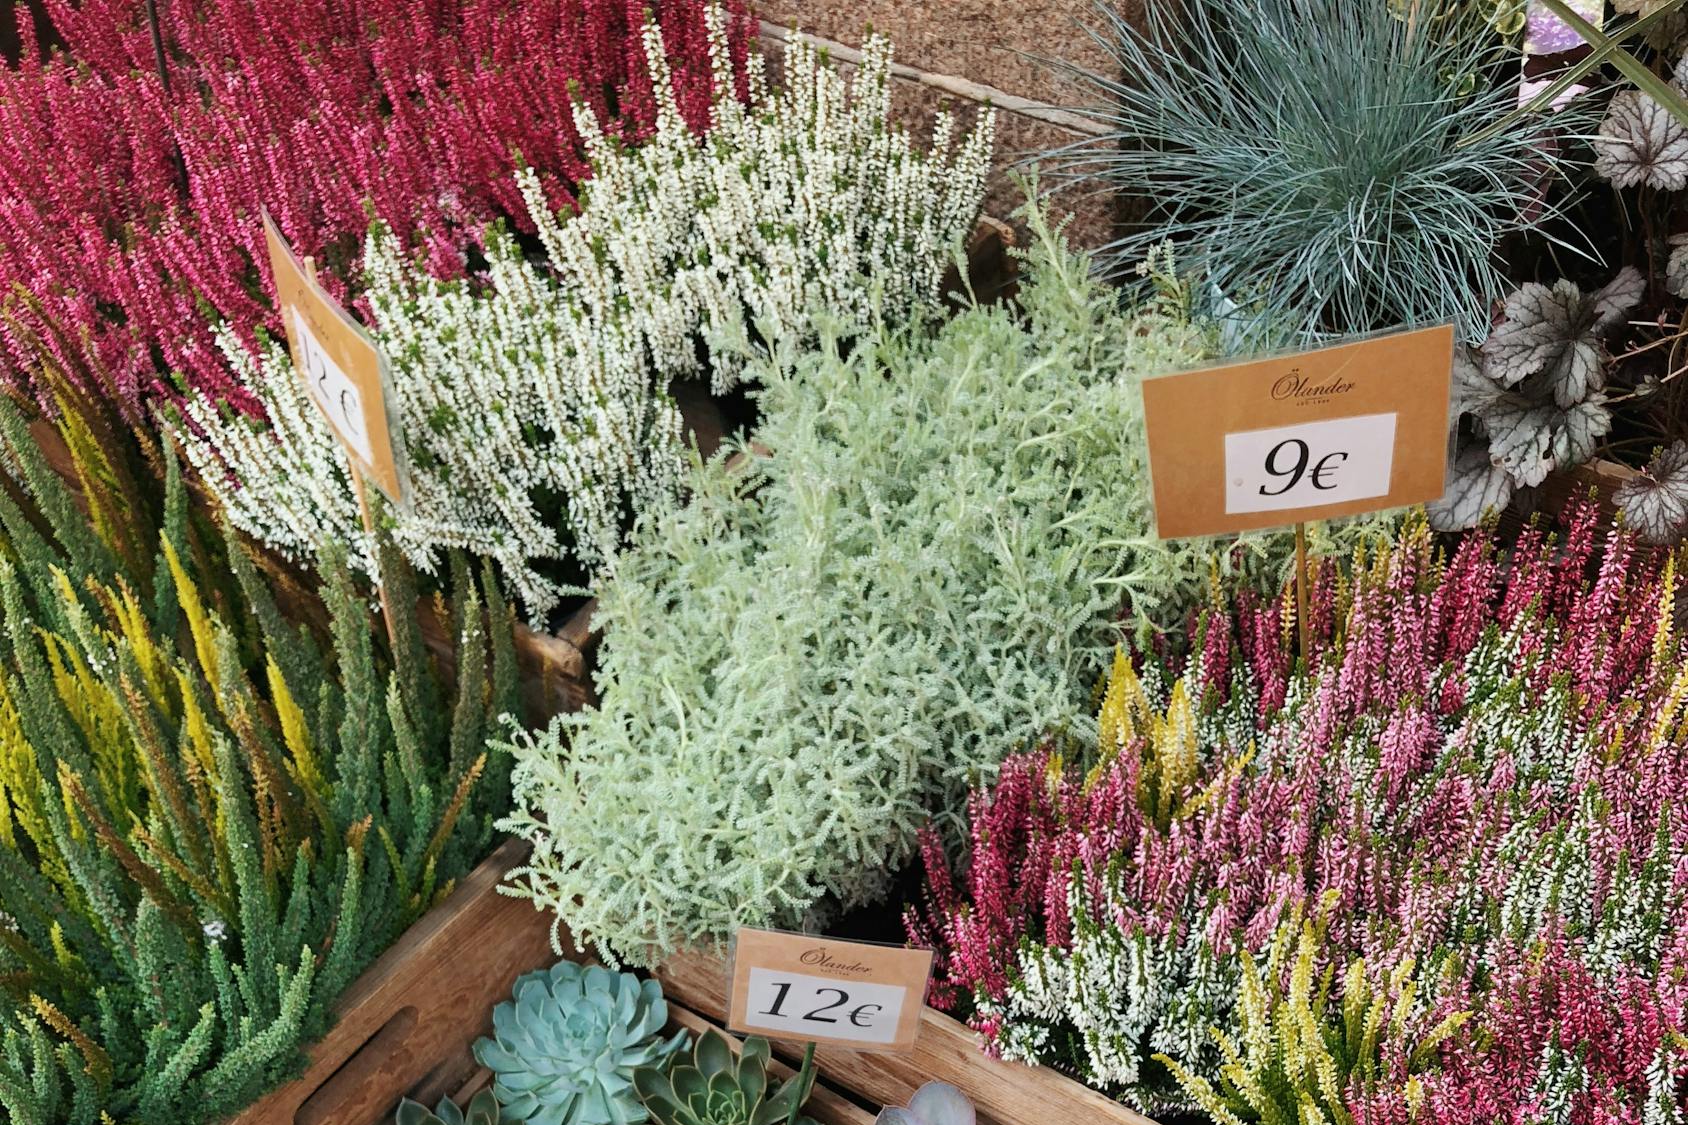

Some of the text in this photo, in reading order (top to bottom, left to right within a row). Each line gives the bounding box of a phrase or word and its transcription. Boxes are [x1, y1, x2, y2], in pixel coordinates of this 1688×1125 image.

[1271, 368, 1356, 401] Ölander
[1259, 438, 1349, 496] 9€
[800, 947, 873, 973] Ölander
